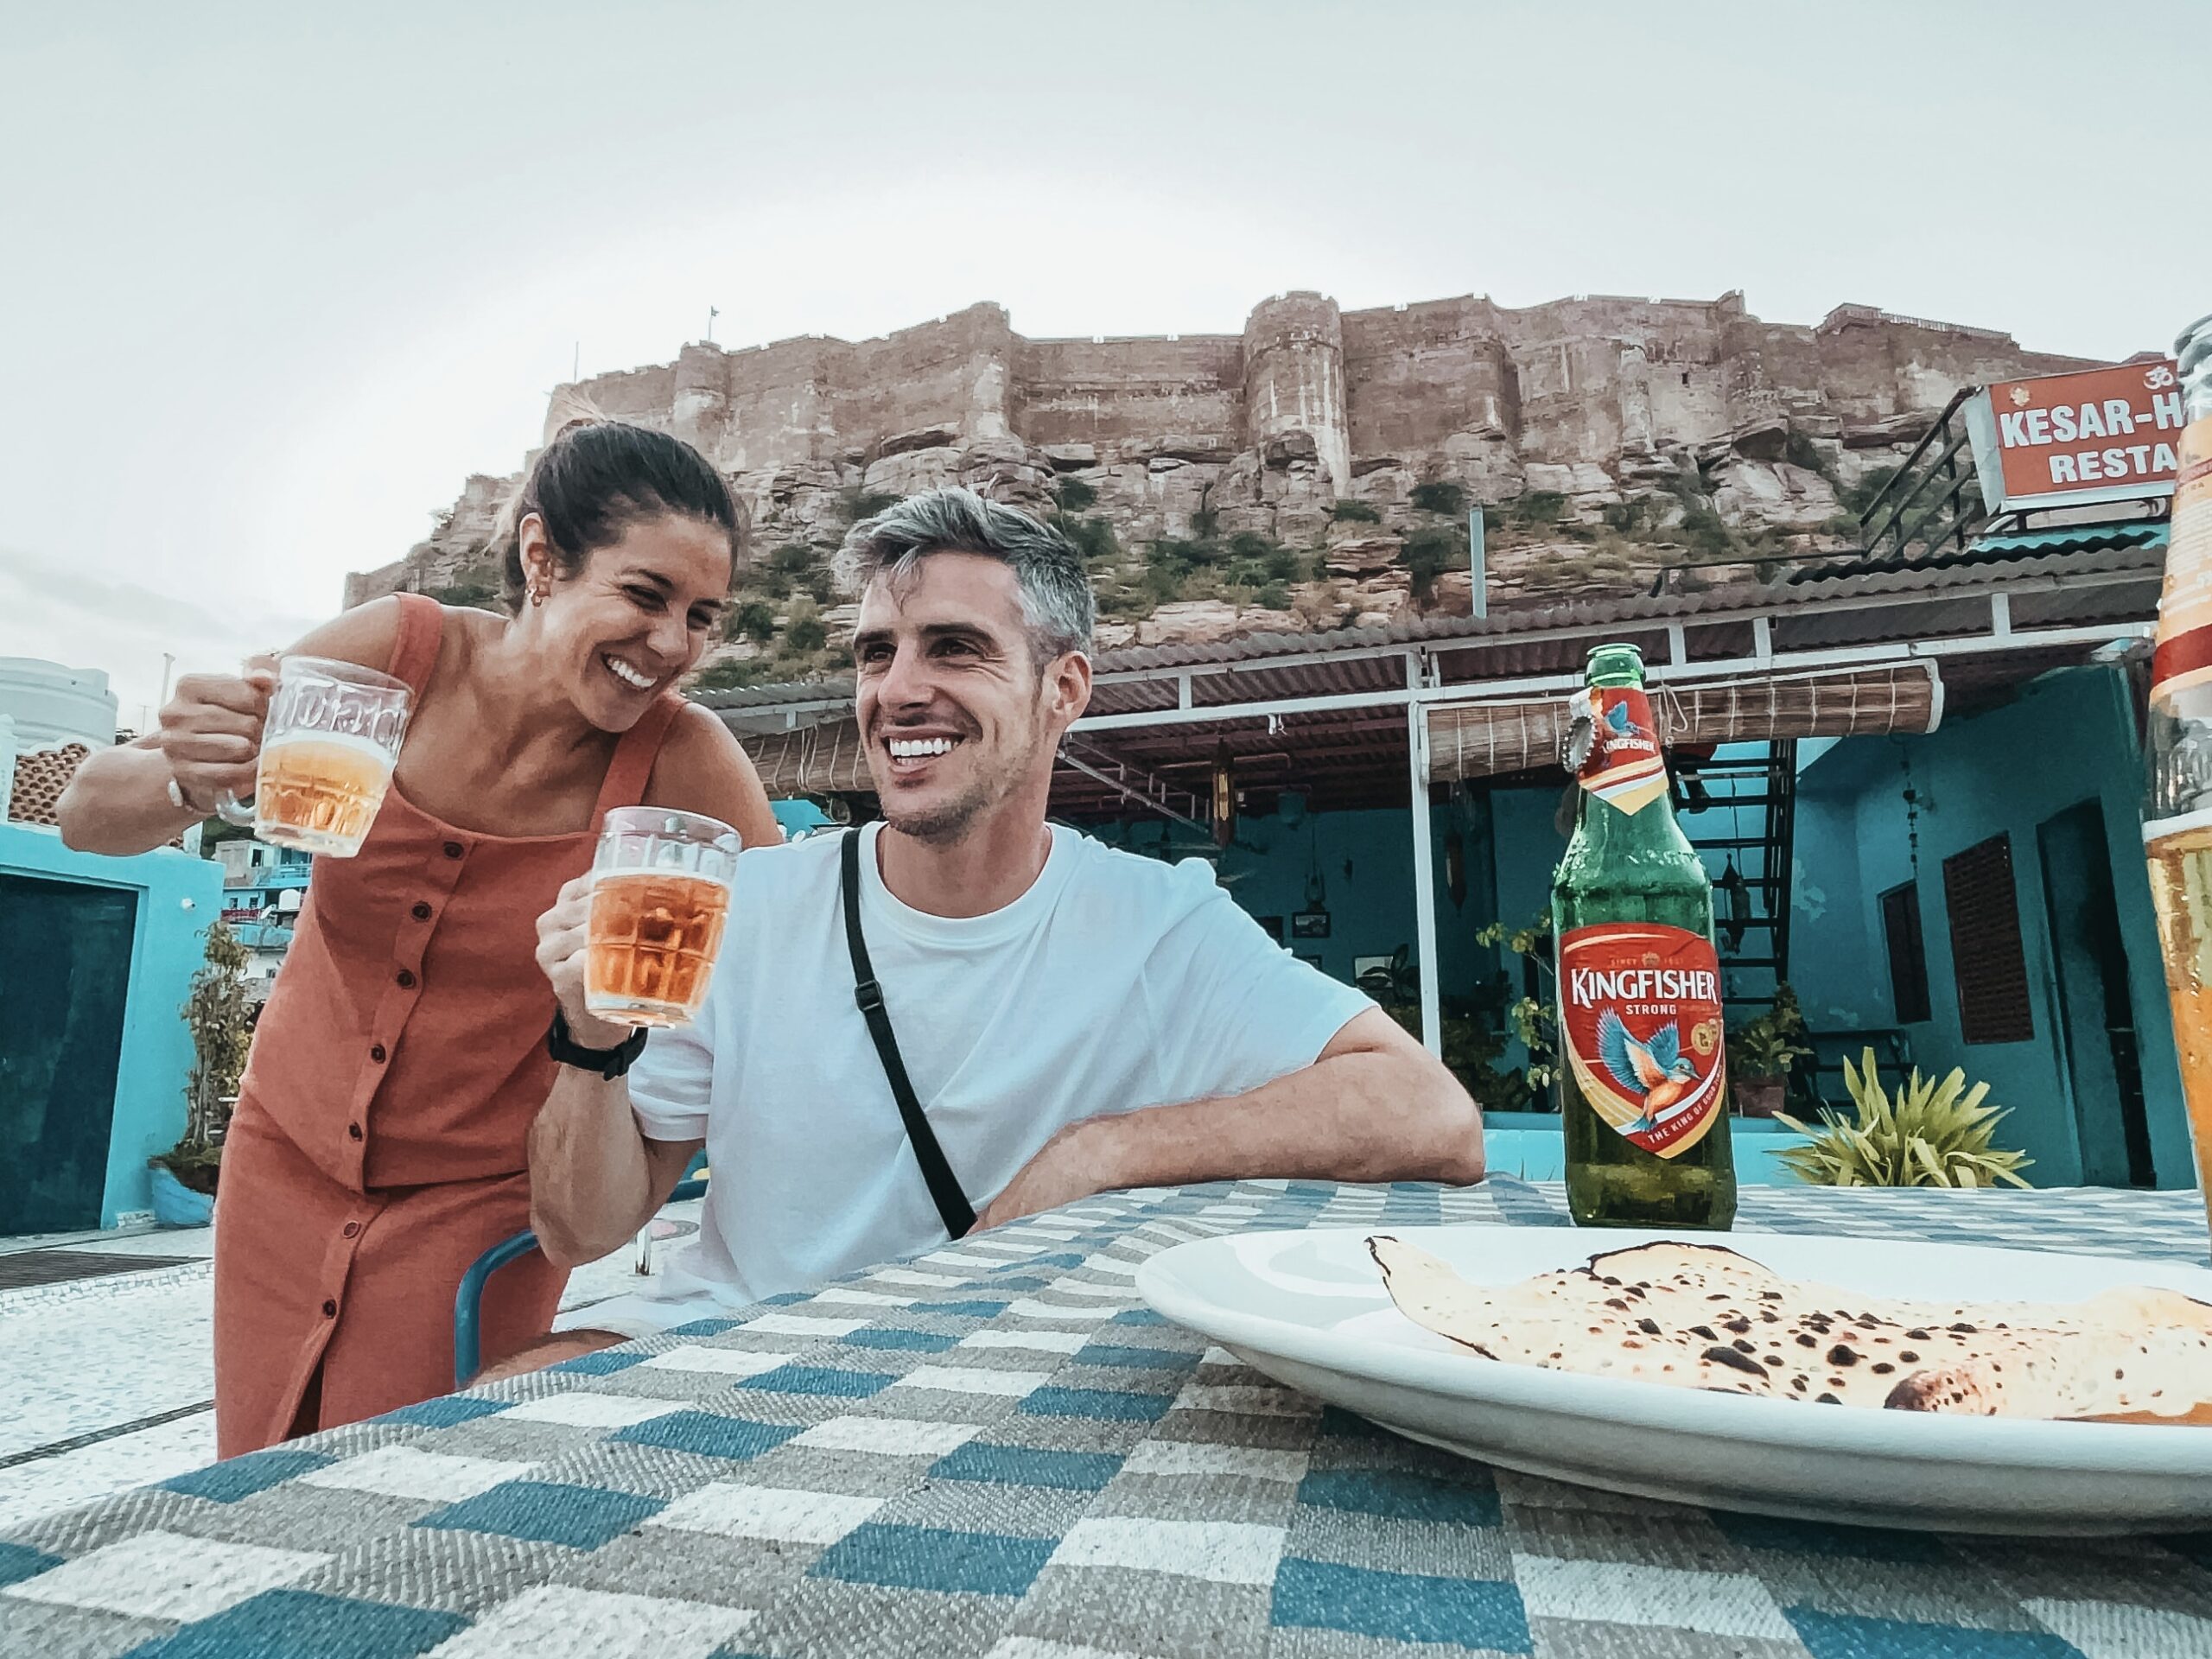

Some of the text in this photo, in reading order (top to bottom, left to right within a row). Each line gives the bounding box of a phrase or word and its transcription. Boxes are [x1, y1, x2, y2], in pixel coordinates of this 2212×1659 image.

[1999, 391, 2185, 448] KESAR-H
[2048, 442, 2179, 484] RESTA
[1571, 968, 1718, 1008] KINGFISHER
[1625, 1004, 1677, 1016] STRONG
[1647, 1128, 1670, 1143] THE
[1670, 1112, 1694, 1132] KING
[1693, 1103, 1704, 1116] OF
